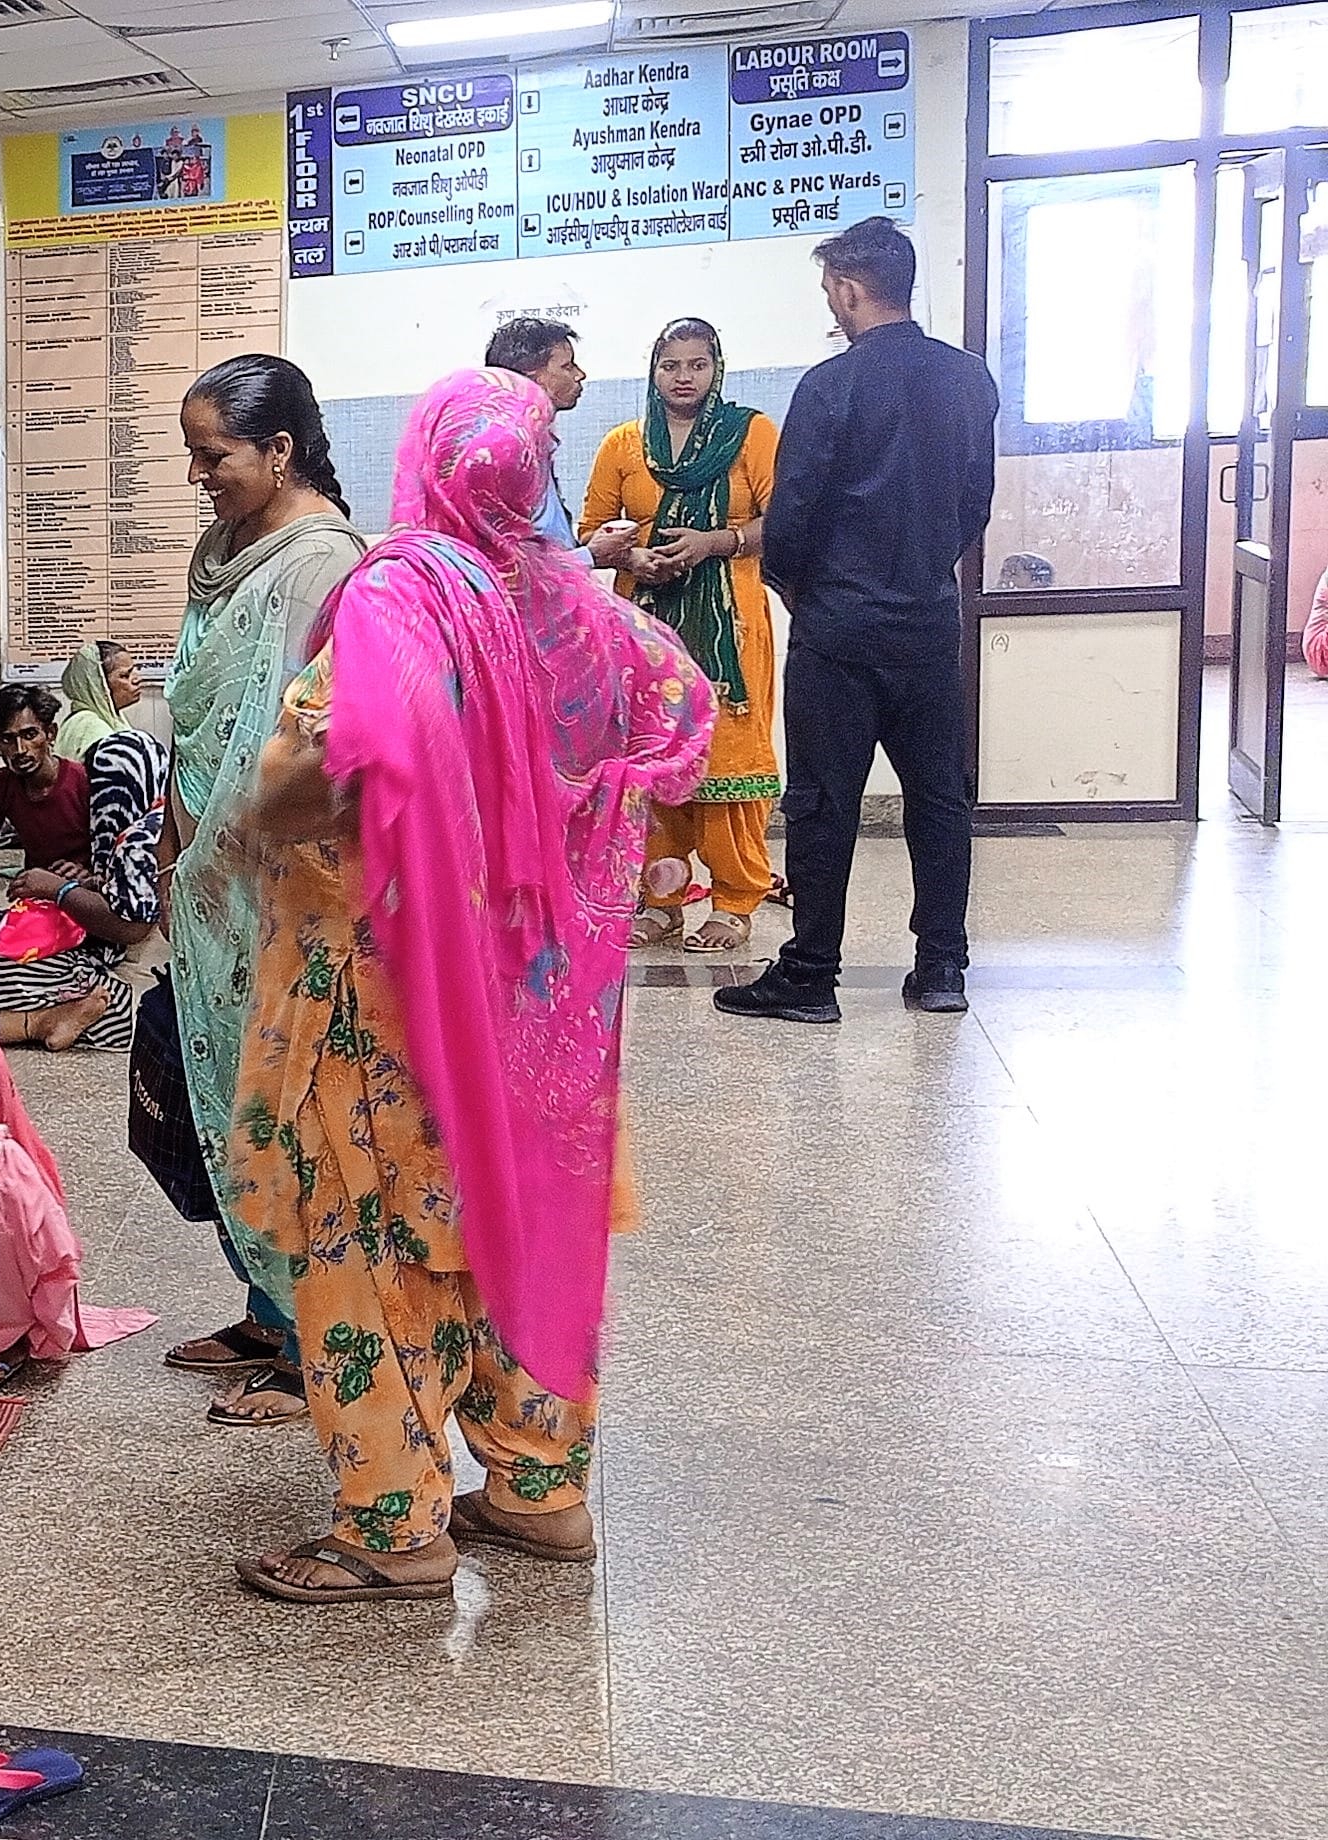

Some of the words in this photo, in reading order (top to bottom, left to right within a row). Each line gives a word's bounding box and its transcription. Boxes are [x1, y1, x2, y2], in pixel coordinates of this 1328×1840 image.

[736, 46, 814, 71] LABOUR
[820, 39, 877, 63] ROOM
[584, 68, 634, 89] Aadhar
[639, 62, 689, 83] Kendra
[769, 66, 809, 98] प्रसूति
[812, 70, 841, 88] कक्ष
[402, 82, 473, 107] SNCU
[603, 95, 638, 116] आधार
[642, 86, 669, 115] केन्द्र
[290, 103, 323, 130] 1st
[366, 117, 407, 135] नवजात
[409, 108, 434, 137] शिशु
[435, 106, 475, 129] देखरेख
[477, 98, 510, 127] इकाई
[750, 113, 813, 135] Gynae
[820, 105, 862, 125] OPD
[573, 125, 645, 150] Ayushman
[651, 118, 700, 139] Kendra
[740, 139, 766, 163] स्त्री
[770, 138, 797, 160] रोग
[802, 130, 872, 158] ओ.पी.डी.
[396, 144, 452, 165] Neonatal
[459, 141, 485, 159] OPD
[591, 150, 644, 180] आयुष्मान
[648, 142, 675, 171] केन्द्र
[296, 131, 317, 208] FLOOR
[393, 180, 428, 198] नवजात
[432, 173, 452, 200] शिशु
[547, 190, 606, 213] ICU/HDU
[612, 189, 621, 207] &
[627, 184, 687, 206] Isolation
[692, 179, 728, 200] Ward
[732, 181, 766, 198] ANC
[773, 179, 784, 194] &
[791, 176, 824, 193] PNC
[829, 172, 881, 189] Wards
[289, 217, 329, 237] प्रथम
[368, 205, 473, 230] ROP/Counselling
[479, 202, 514, 219] Room
[632, 220, 639, 236] व
[643, 209, 705, 237] आइसोलेशन
[708, 205, 727, 230] वार्ड
[772, 200, 810, 230] प्रसूति
[814, 196, 840, 220] वार्ड
[393, 241, 412, 259] आर
[414, 235, 425, 257] ओ
